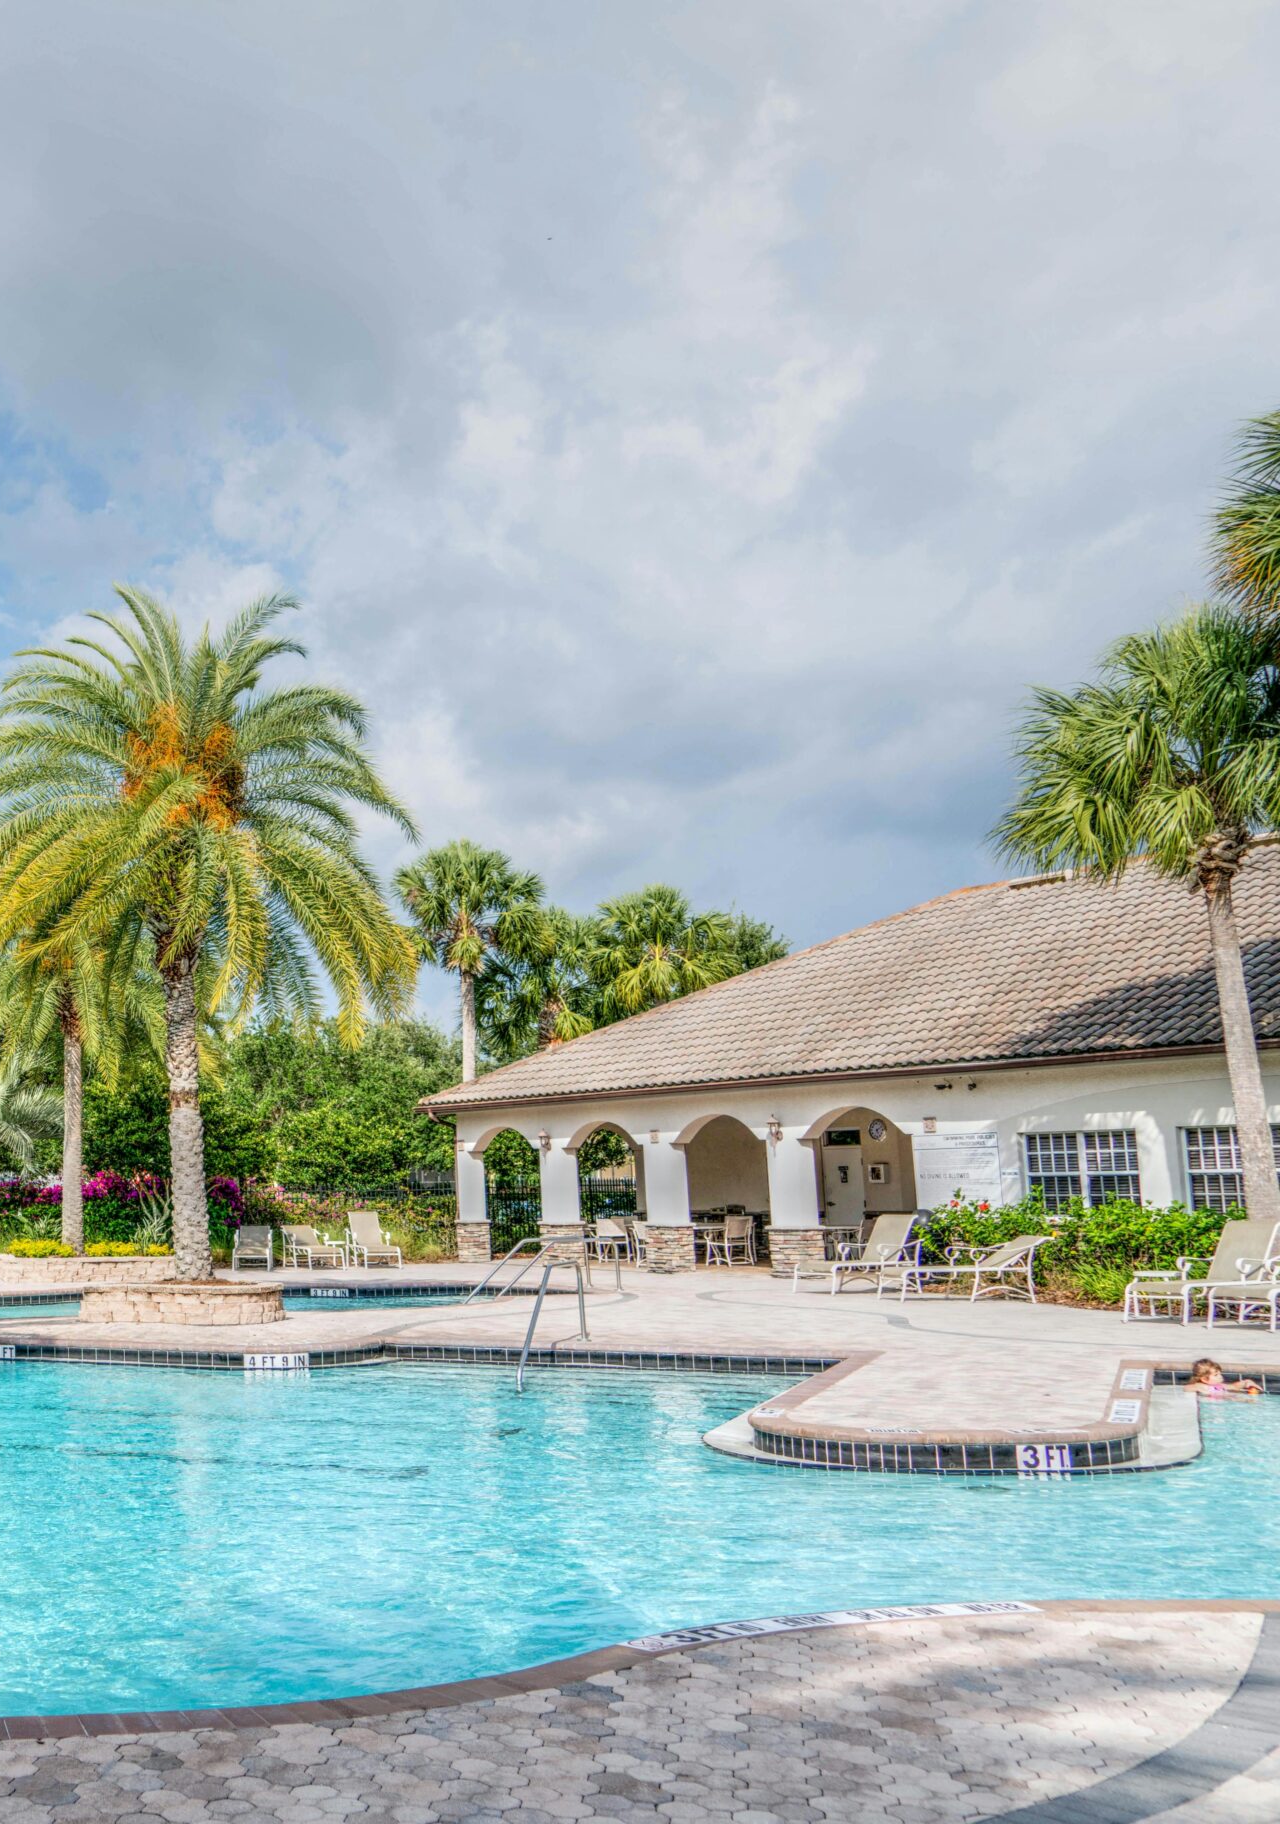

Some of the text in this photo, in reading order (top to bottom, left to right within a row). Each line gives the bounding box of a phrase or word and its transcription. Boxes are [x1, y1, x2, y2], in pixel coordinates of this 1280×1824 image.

[3, 1346, 15, 1358] FT
[249, 1356, 256, 1366] 4
[262, 1355, 276, 1367] FT
[282, 1355, 289, 1366] 9
[1023, 1445, 1069, 1469] 3 FT.
[661, 1633, 702, 1642] 3
